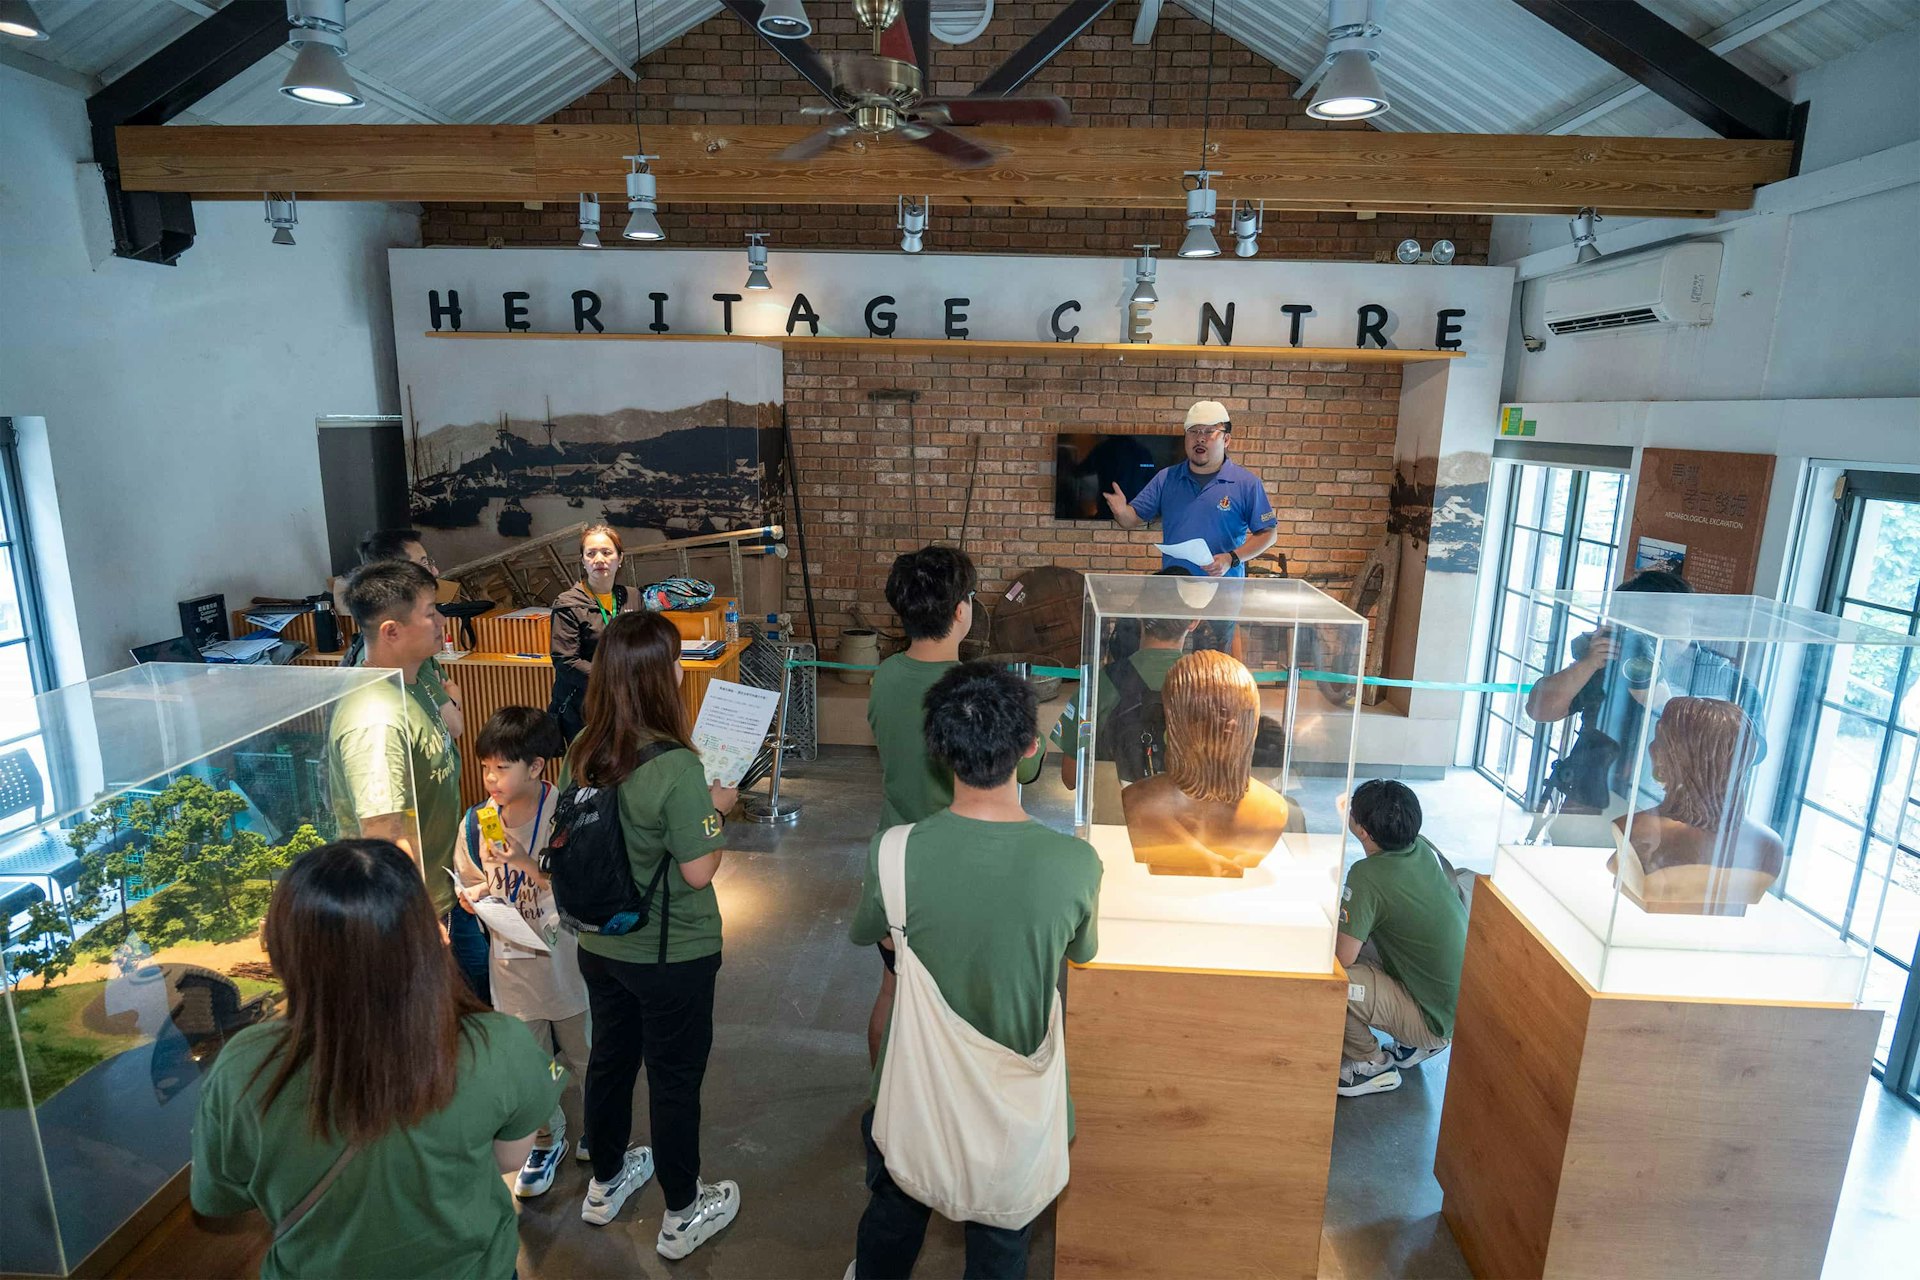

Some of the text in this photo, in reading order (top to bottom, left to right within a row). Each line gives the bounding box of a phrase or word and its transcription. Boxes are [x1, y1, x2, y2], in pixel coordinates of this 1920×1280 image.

[428, 290, 1466, 349] HERITAGE CENTRE
[1664, 511, 1744, 529] ARCHAEOLOGICAL EXCAVATION
